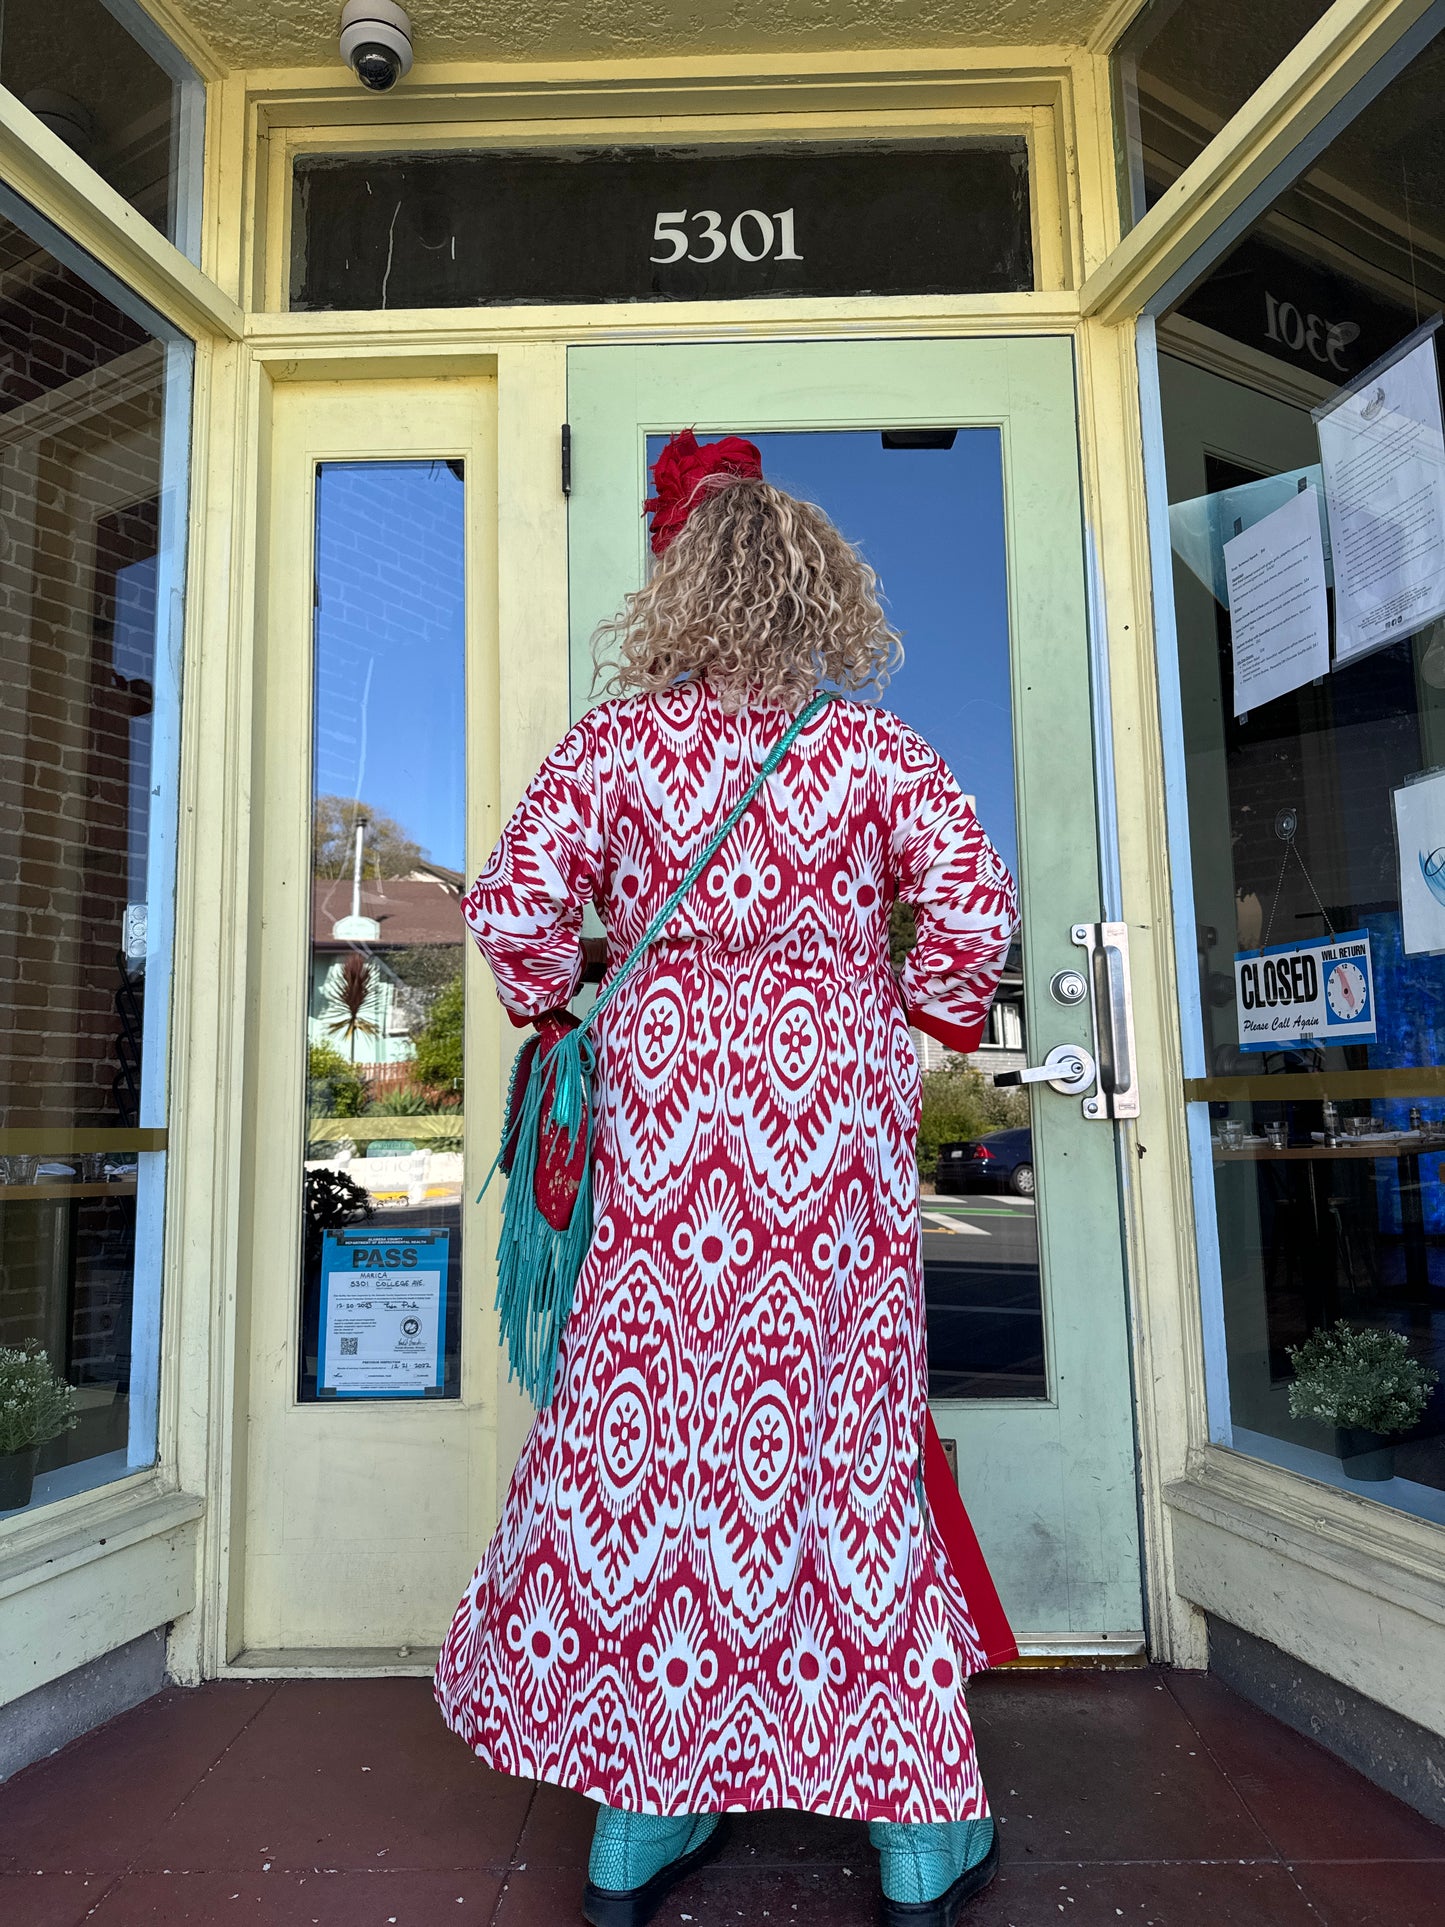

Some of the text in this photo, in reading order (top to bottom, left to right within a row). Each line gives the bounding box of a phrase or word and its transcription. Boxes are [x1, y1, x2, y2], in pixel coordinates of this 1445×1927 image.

[649, 207, 804, 264] 5301
[1321, 944, 1366, 961] WILL RETURN
[1240, 954, 1318, 1010] CLOSED
[1243, 1014, 1319, 1032] Please Call Again
[352, 1248, 418, 1268] PASS
